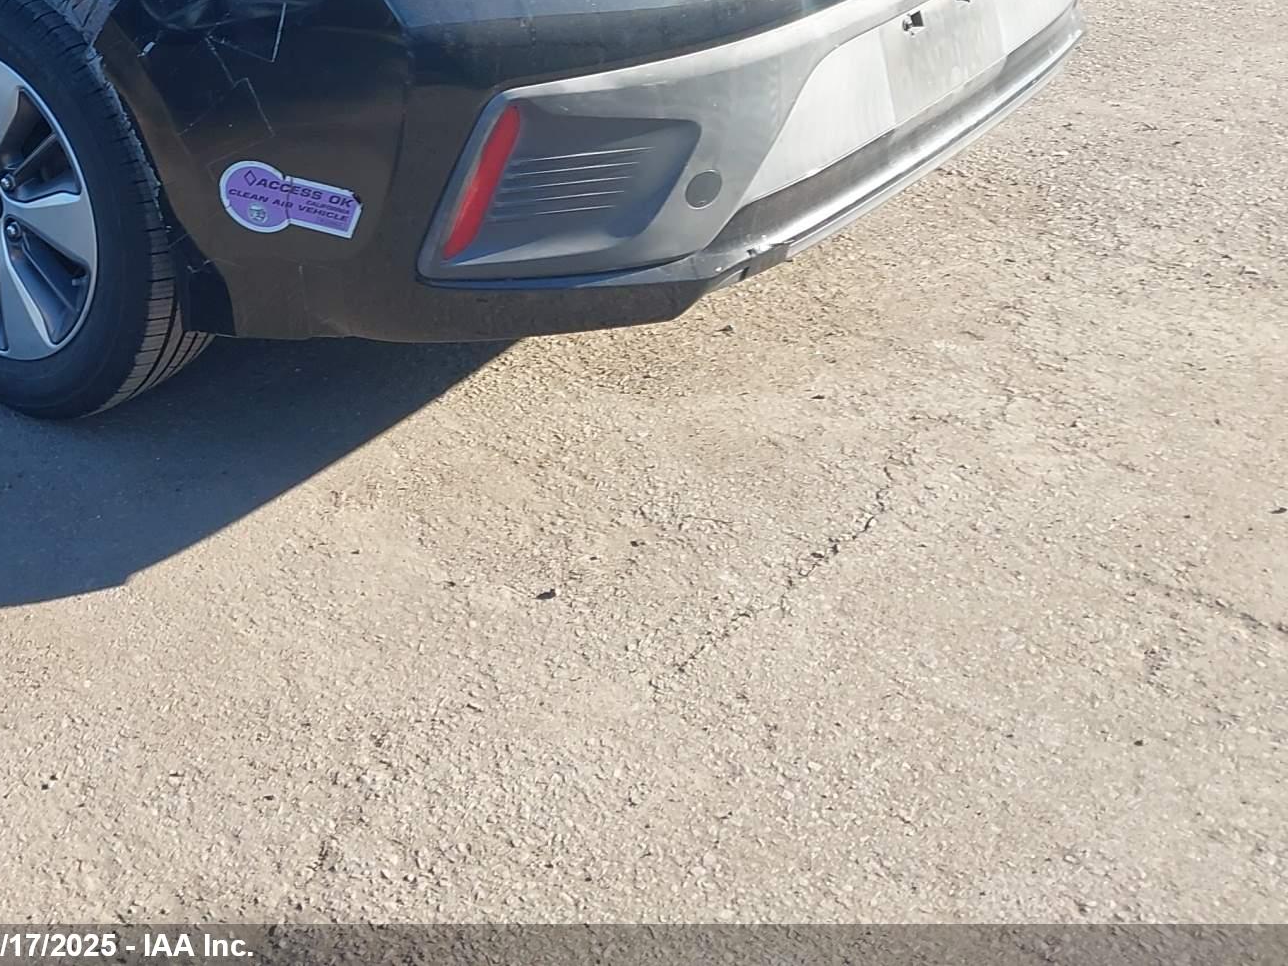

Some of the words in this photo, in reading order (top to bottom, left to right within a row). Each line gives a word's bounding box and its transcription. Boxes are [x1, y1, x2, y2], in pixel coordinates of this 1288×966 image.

[228, 188, 269, 203] CLEAN
[272, 199, 293, 209] AIR
[298, 205, 348, 221] VEHICLE
[256, 178, 323, 200] ACCESS
[328, 195, 354, 208] OK
